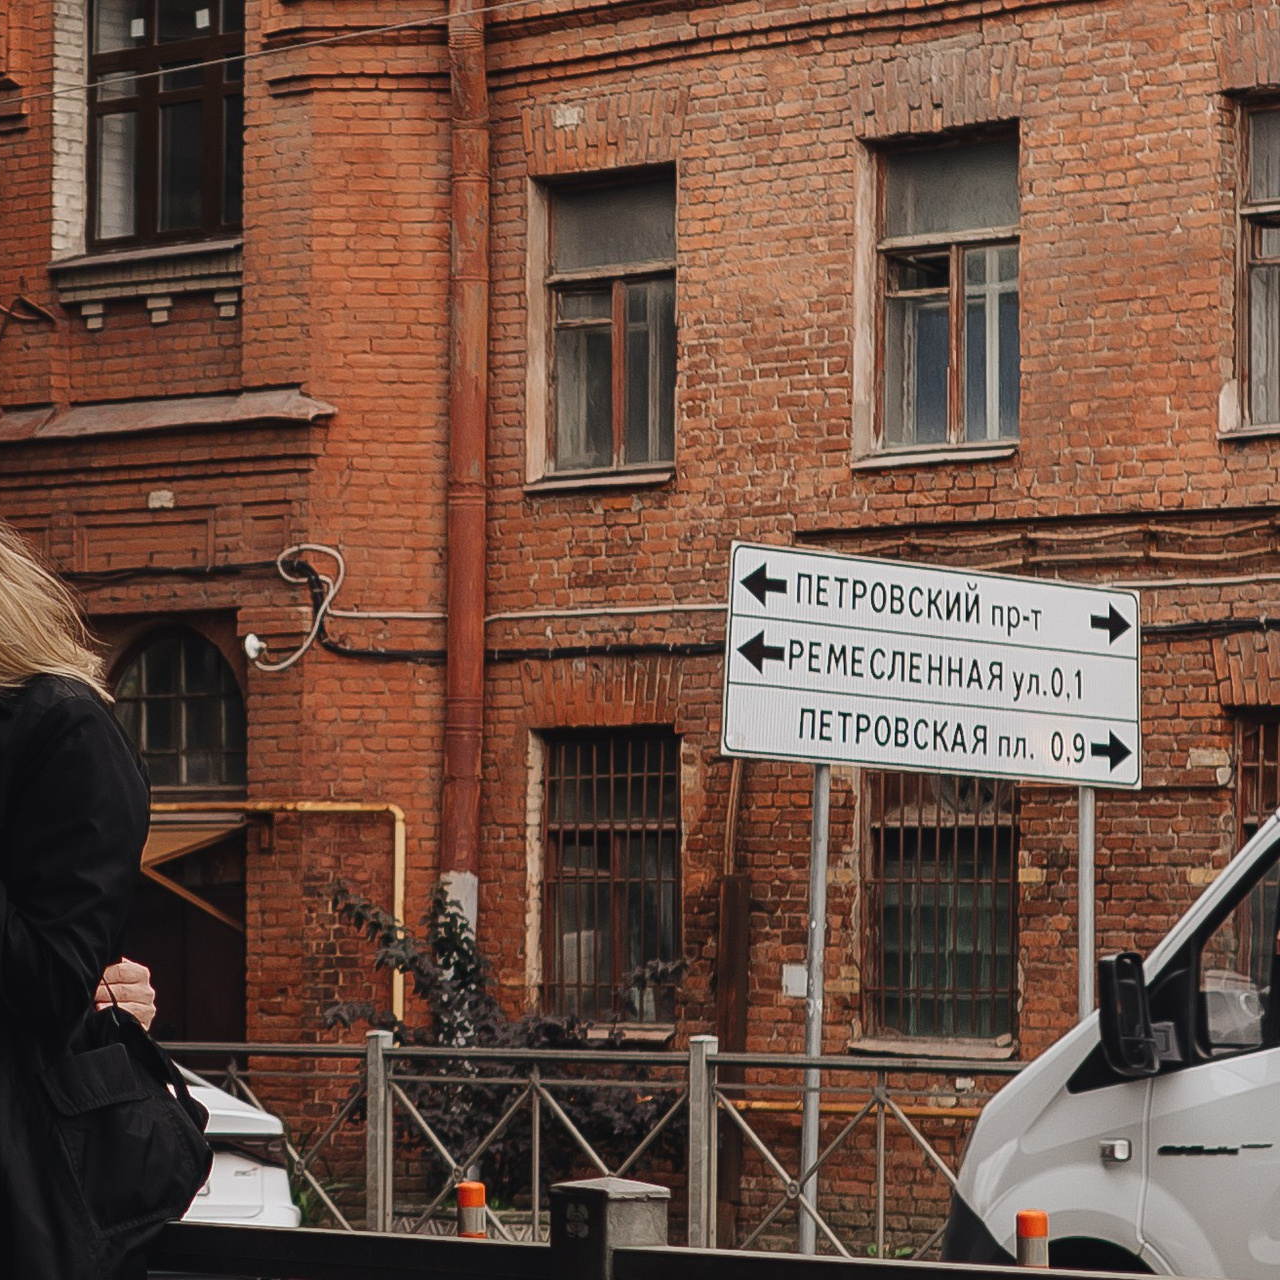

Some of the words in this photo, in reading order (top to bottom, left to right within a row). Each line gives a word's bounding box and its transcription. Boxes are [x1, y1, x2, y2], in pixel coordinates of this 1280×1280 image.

[796, 572, 981, 624] ПЕТРОВСКИЙ
[991, 605, 1043, 637] пр-т
[788, 639, 1004, 693] РЕМЕСЛЕННАЯ
[798, 707, 988, 756] ПЕТРОВСКАЯ
[998, 735, 1036, 761] пл.
[1051, 731, 1086, 766] 0,9
